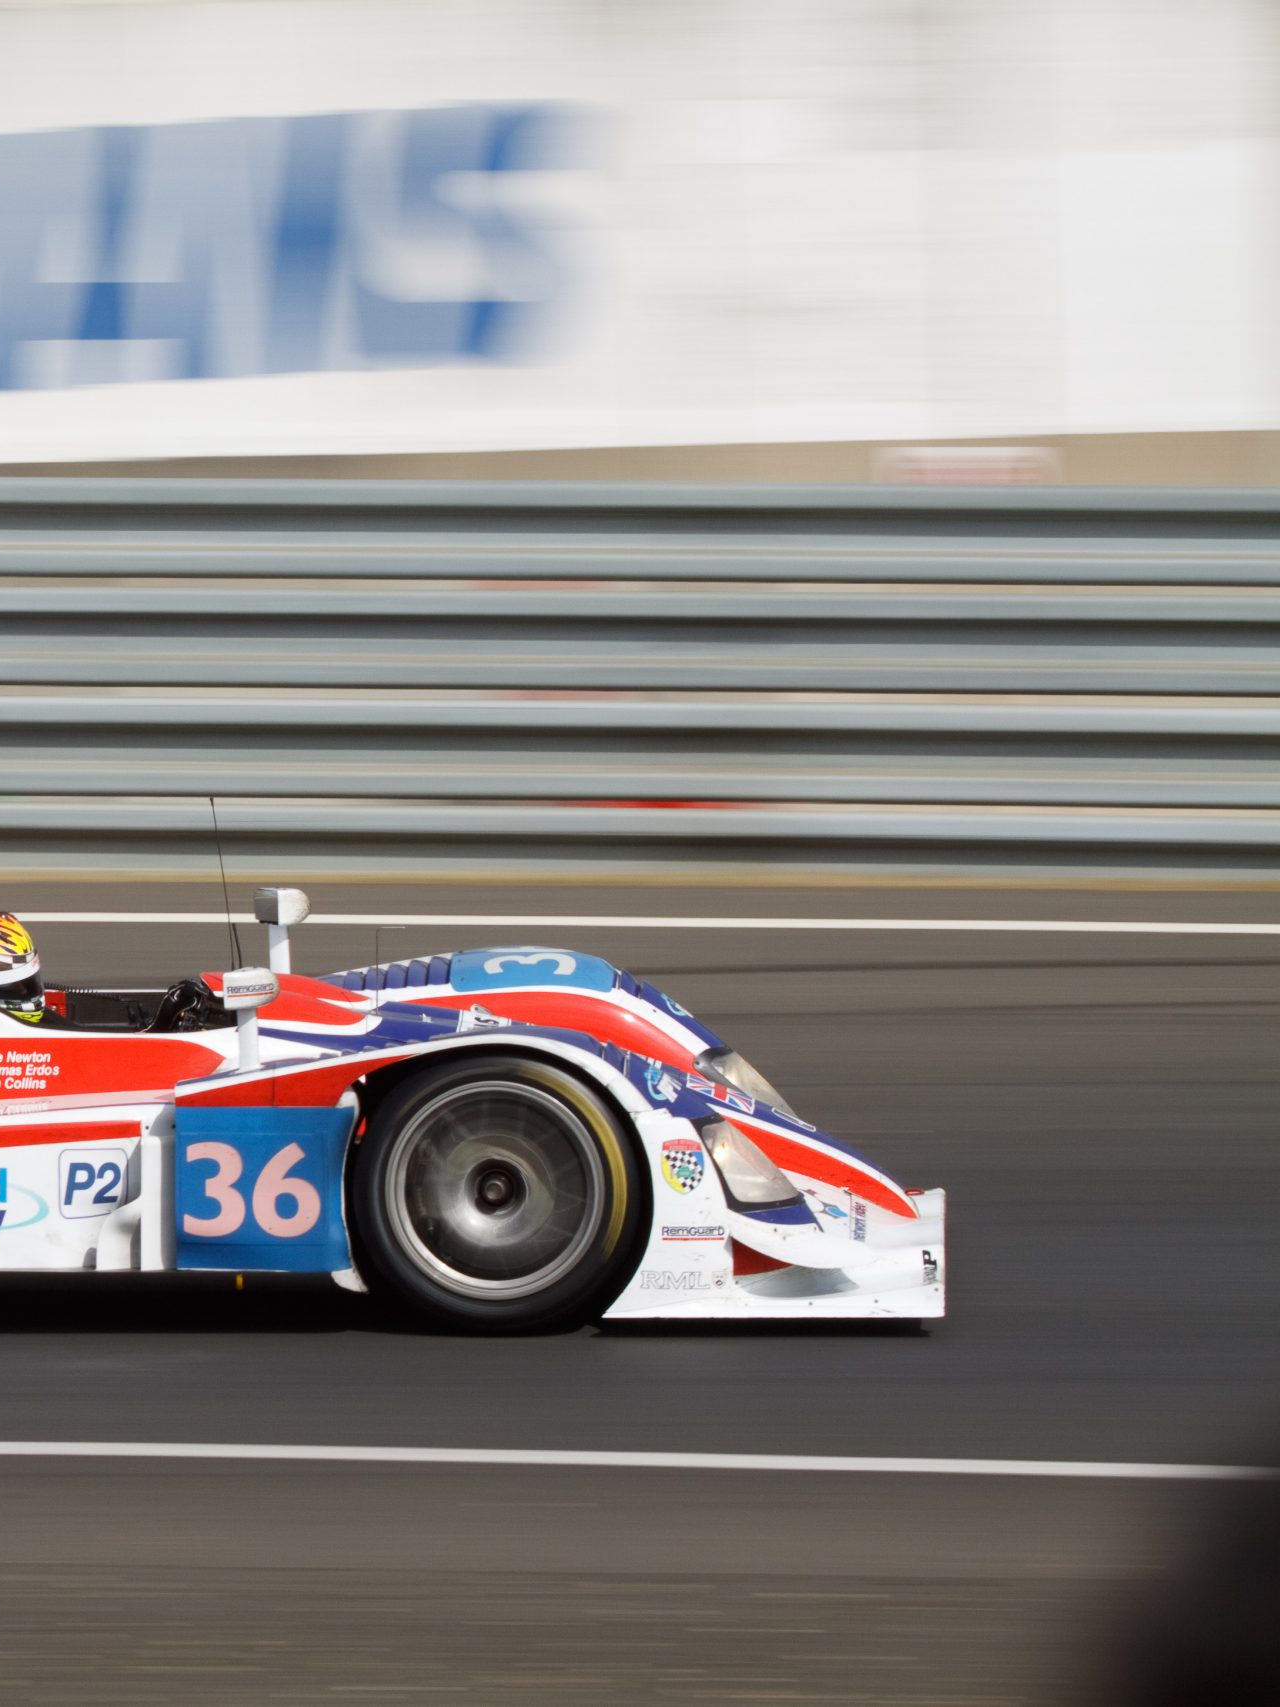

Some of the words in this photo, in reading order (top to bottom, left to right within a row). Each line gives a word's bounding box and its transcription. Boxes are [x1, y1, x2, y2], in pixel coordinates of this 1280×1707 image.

[6, 1050, 52, 1063] Newton
[25, 1063, 61, 1076] Erdos
[4, 1076, 47, 1090] Collins
[63, 1161, 123, 1206] P2
[182, 1141, 322, 1239] 36
[640, 1270, 711, 1290] RML
